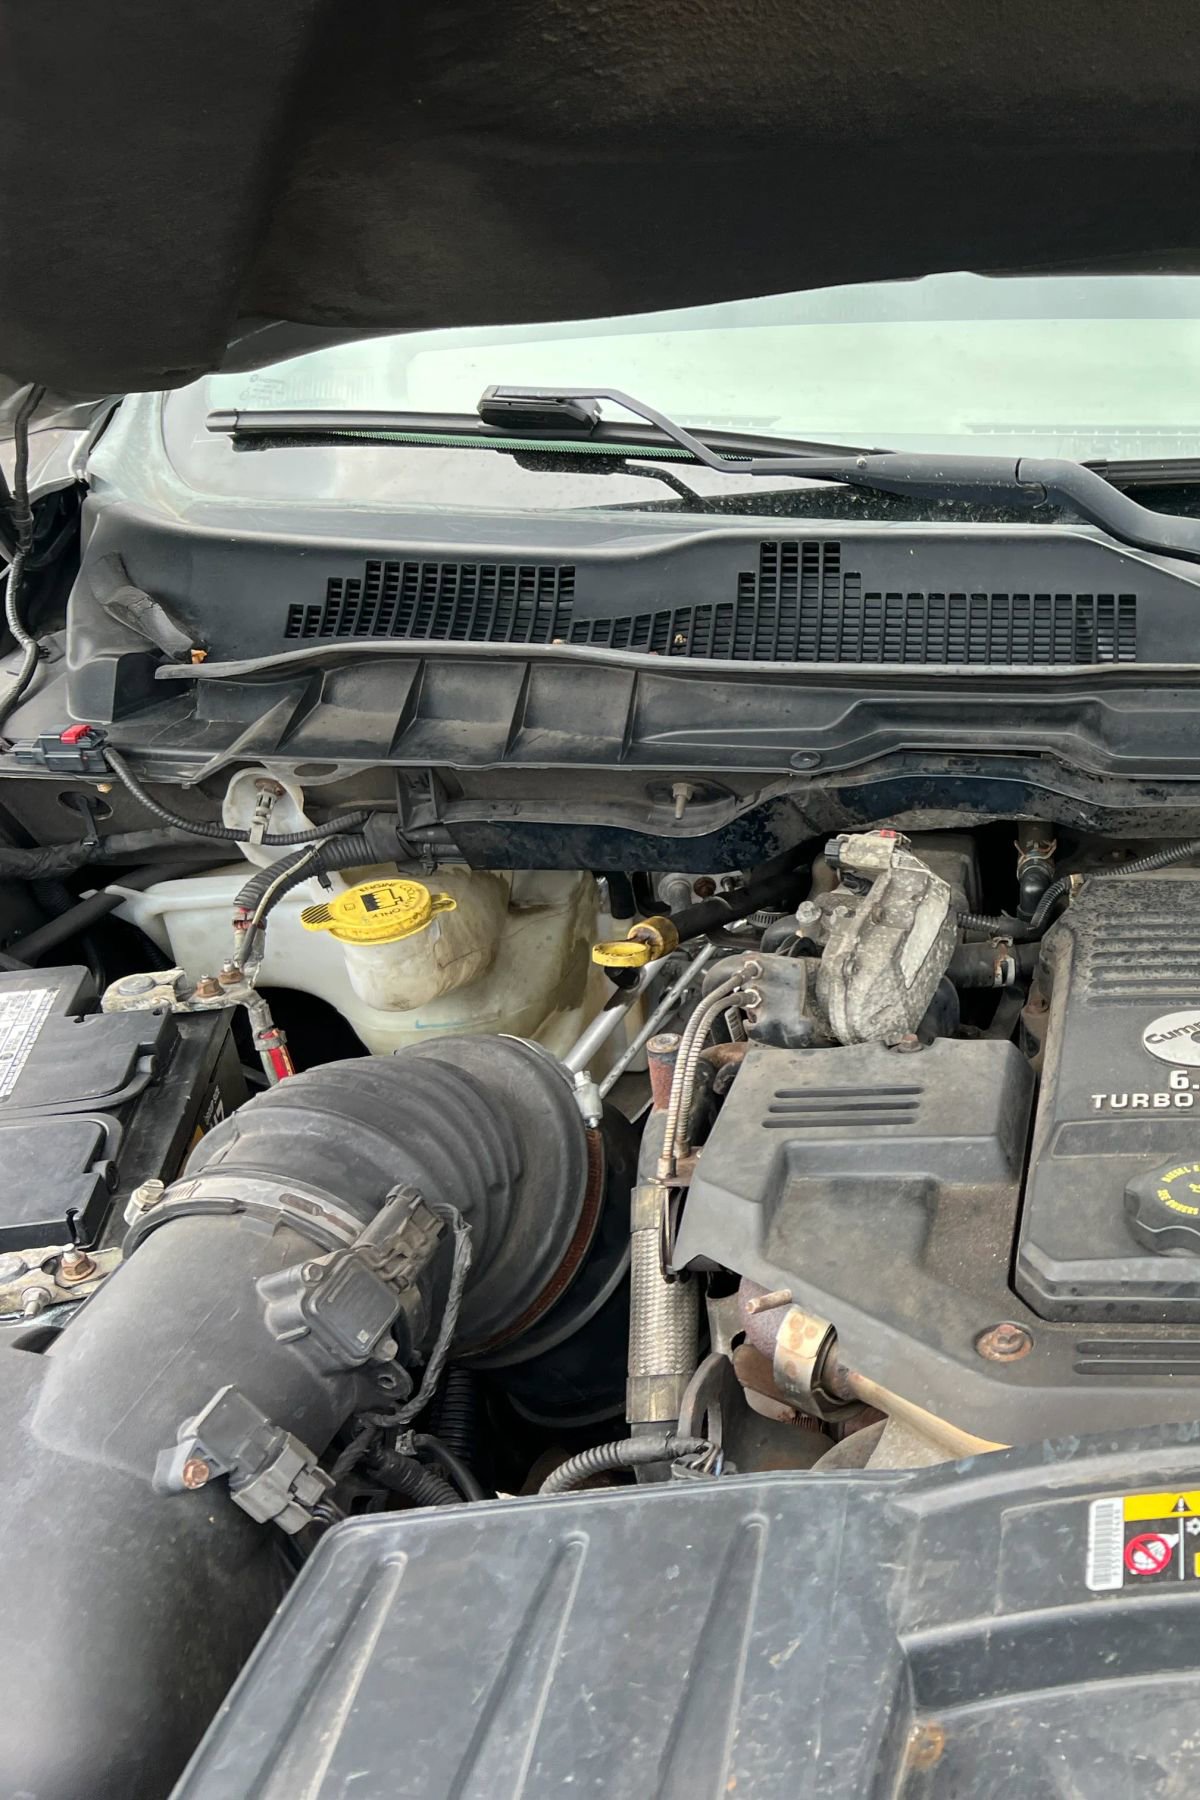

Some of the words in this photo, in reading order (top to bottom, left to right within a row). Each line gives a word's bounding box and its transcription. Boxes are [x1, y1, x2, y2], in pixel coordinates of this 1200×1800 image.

[1092, 1093, 1194, 1110] TURBO
[1162, 1166, 1191, 1182] DIESEL
[1157, 1188, 1171, 1202] SEE
